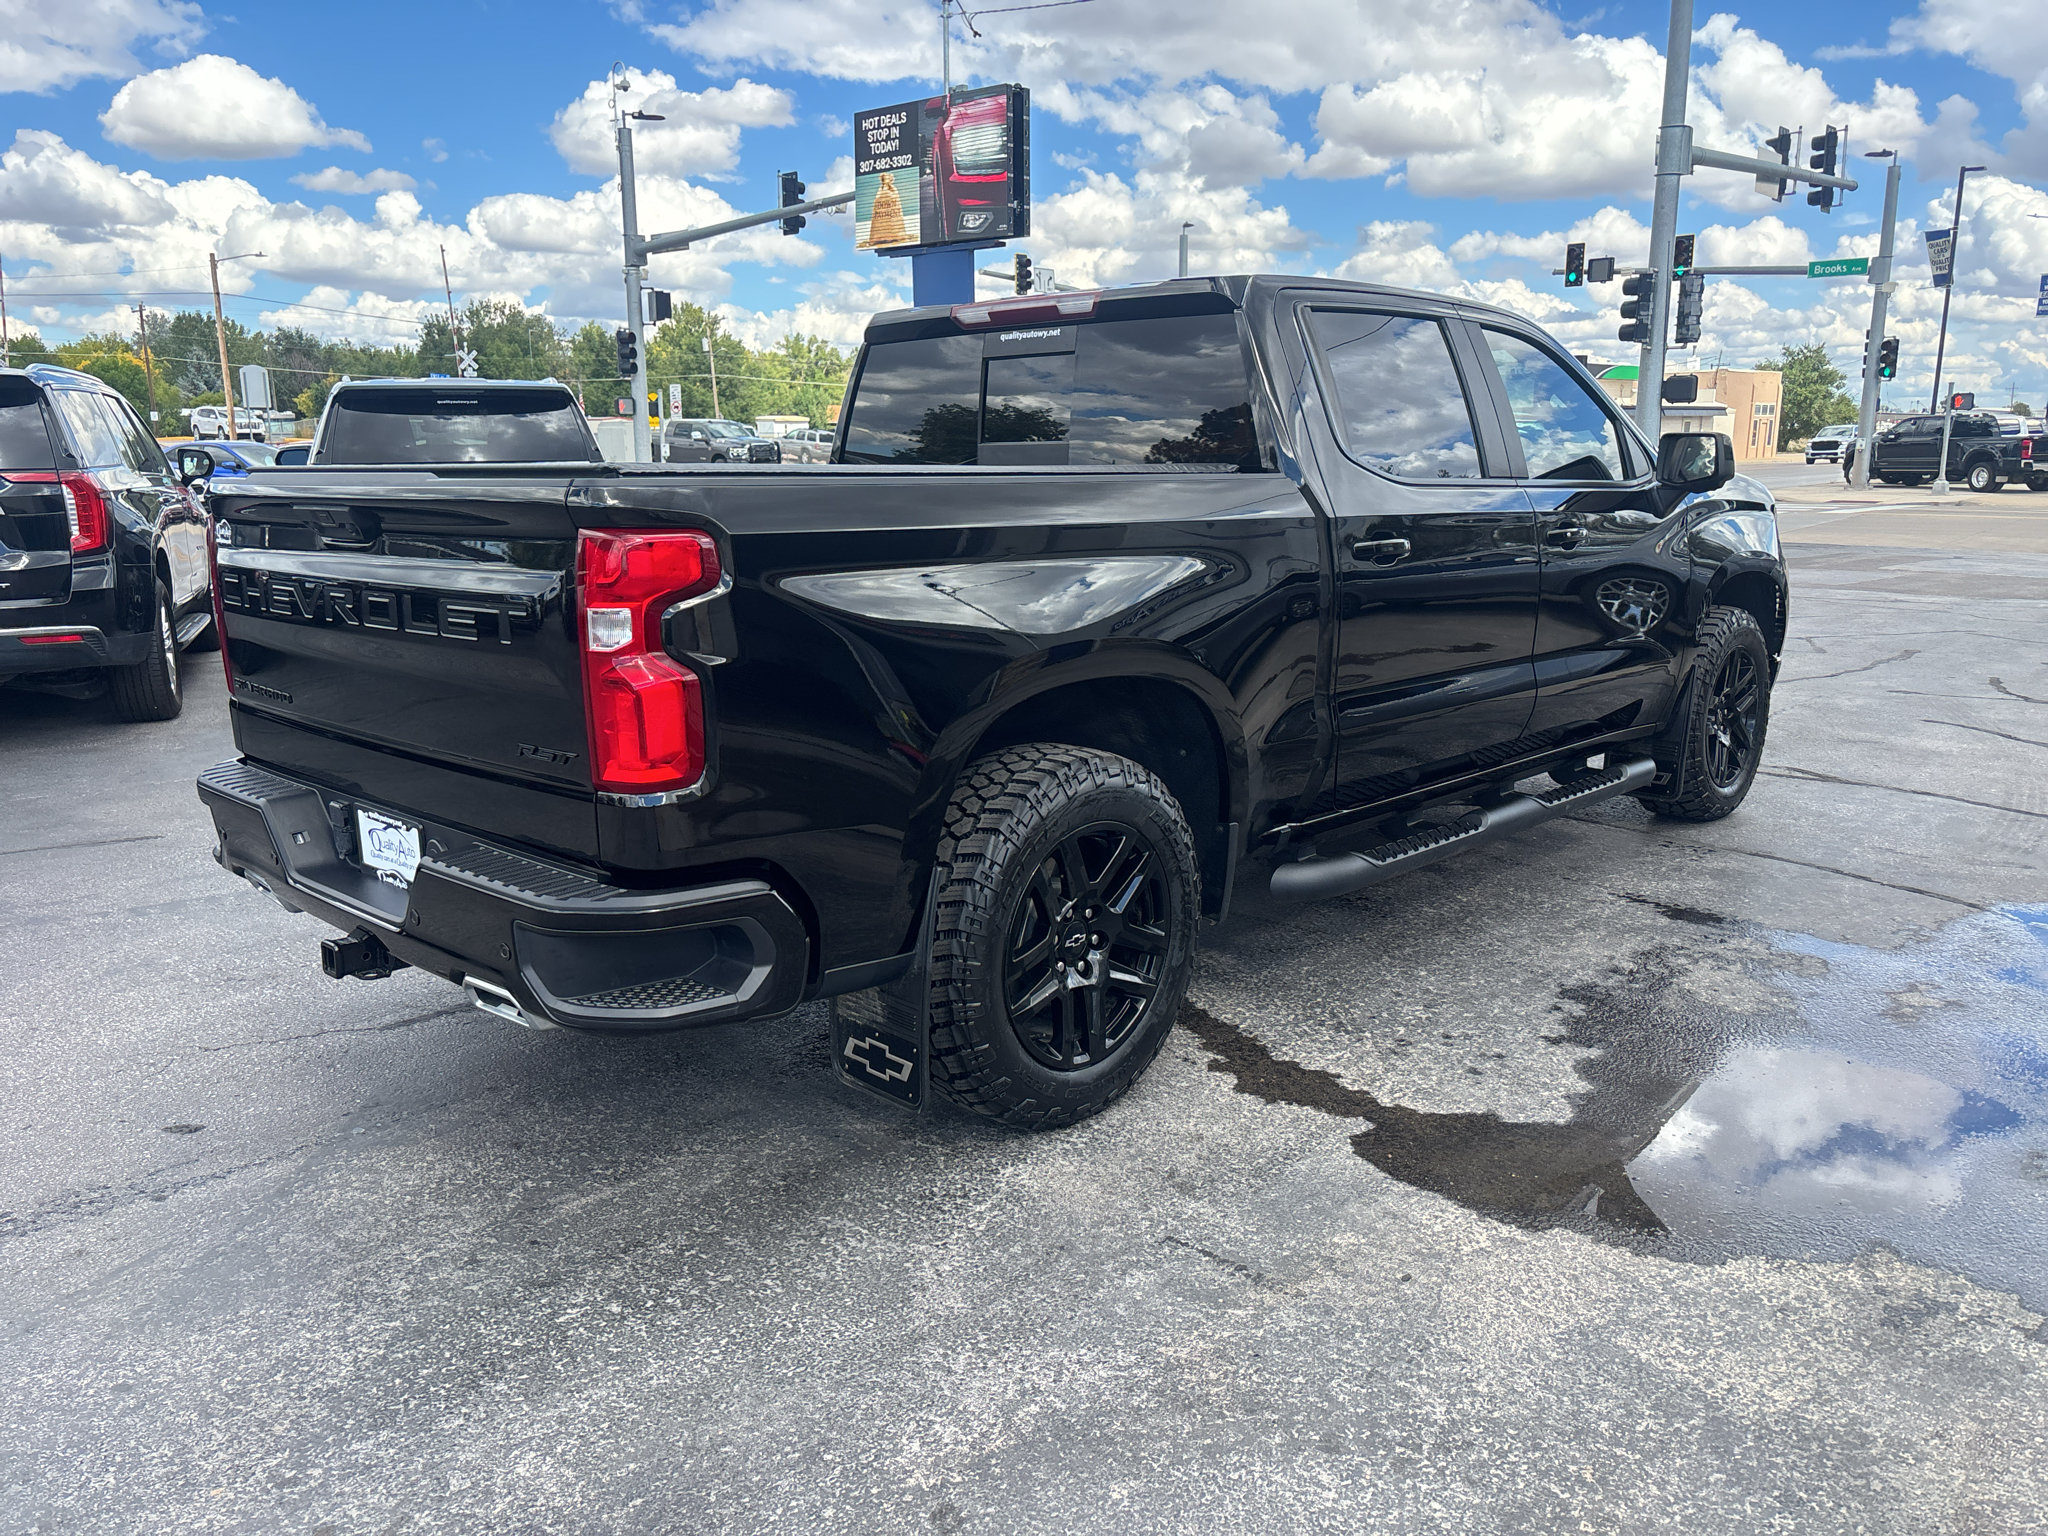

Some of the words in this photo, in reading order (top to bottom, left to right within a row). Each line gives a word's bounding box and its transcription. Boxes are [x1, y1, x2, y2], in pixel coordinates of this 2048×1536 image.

[862, 116, 879, 130] HOT
[880, 112, 907, 127] DEALS
[867, 128, 889, 142] STOP
[890, 126, 899, 138] IN
[870, 139, 899, 155] TODAY!
[859, 154, 912, 173] 307-682-3302
[1813, 264, 1847, 274] Brooks
[1000, 328, 1061, 342] qualityautowy.net
[223, 572, 528, 645] CHEVROLET
